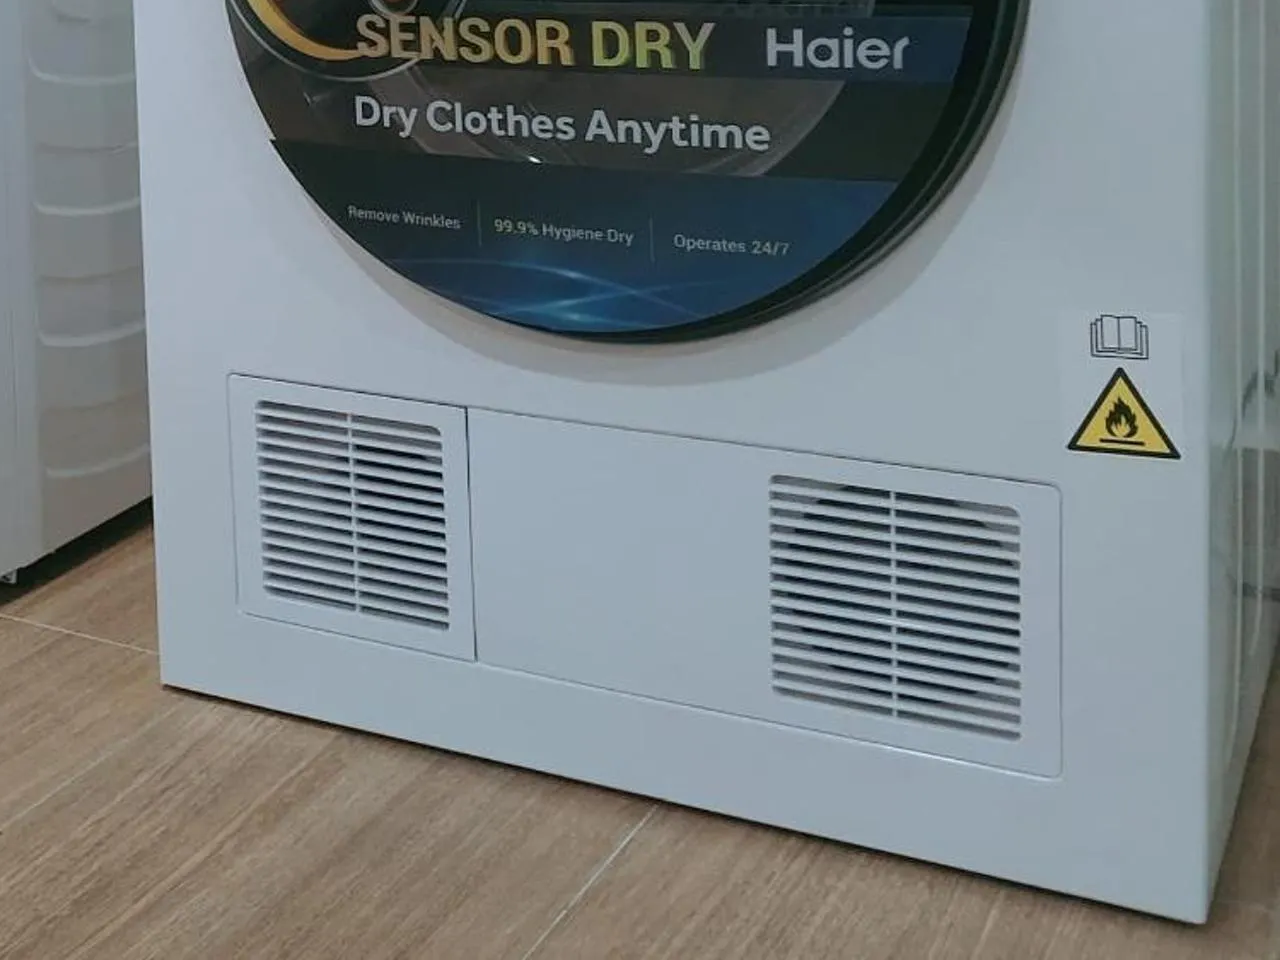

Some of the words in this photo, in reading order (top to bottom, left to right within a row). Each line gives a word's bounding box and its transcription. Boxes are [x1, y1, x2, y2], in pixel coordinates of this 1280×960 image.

[356, 13, 576, 66] SENSOR
[591, 20, 717, 71] DRY
[766, 26, 911, 70] Haier
[355, 95, 418, 139] Dry
[426, 100, 577, 141] Clothes
[584, 109, 771, 155] Anytime
[347, 204, 400, 223] Remove
[402, 211, 462, 230] Wrinkles
[494, 218, 539, 236] 99.9%
[542, 223, 603, 242] Hygiene
[606, 228, 635, 247] Dry
[673, 233, 747, 253] Operates
[751, 240, 791, 257] 24/7
